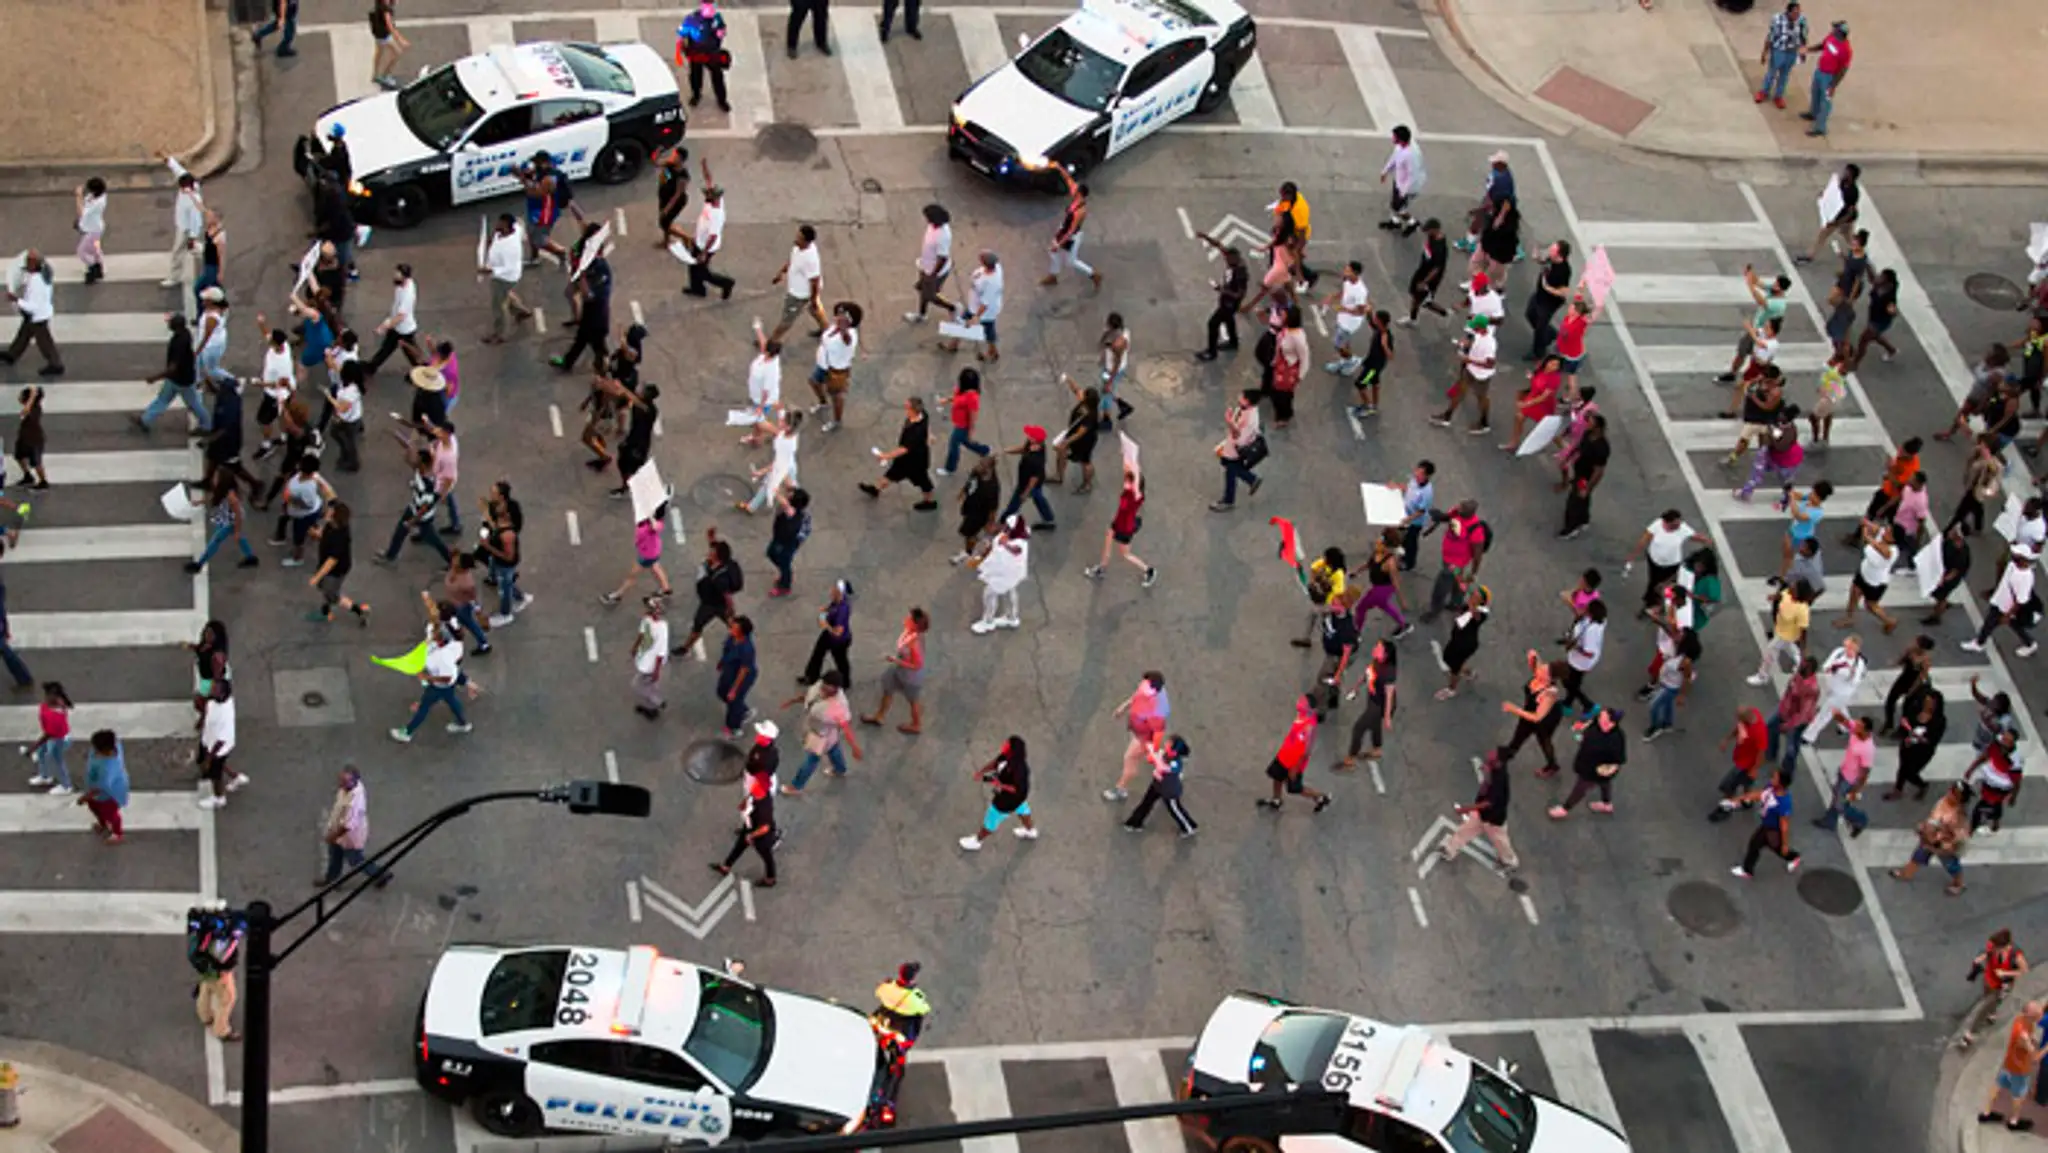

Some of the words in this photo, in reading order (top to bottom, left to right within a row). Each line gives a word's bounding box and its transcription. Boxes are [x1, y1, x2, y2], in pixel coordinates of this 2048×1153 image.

[558, 953, 598, 1025] 2048
[1325, 1021, 1376, 1092] 3156
[544, 1097, 694, 1128] POLICE
